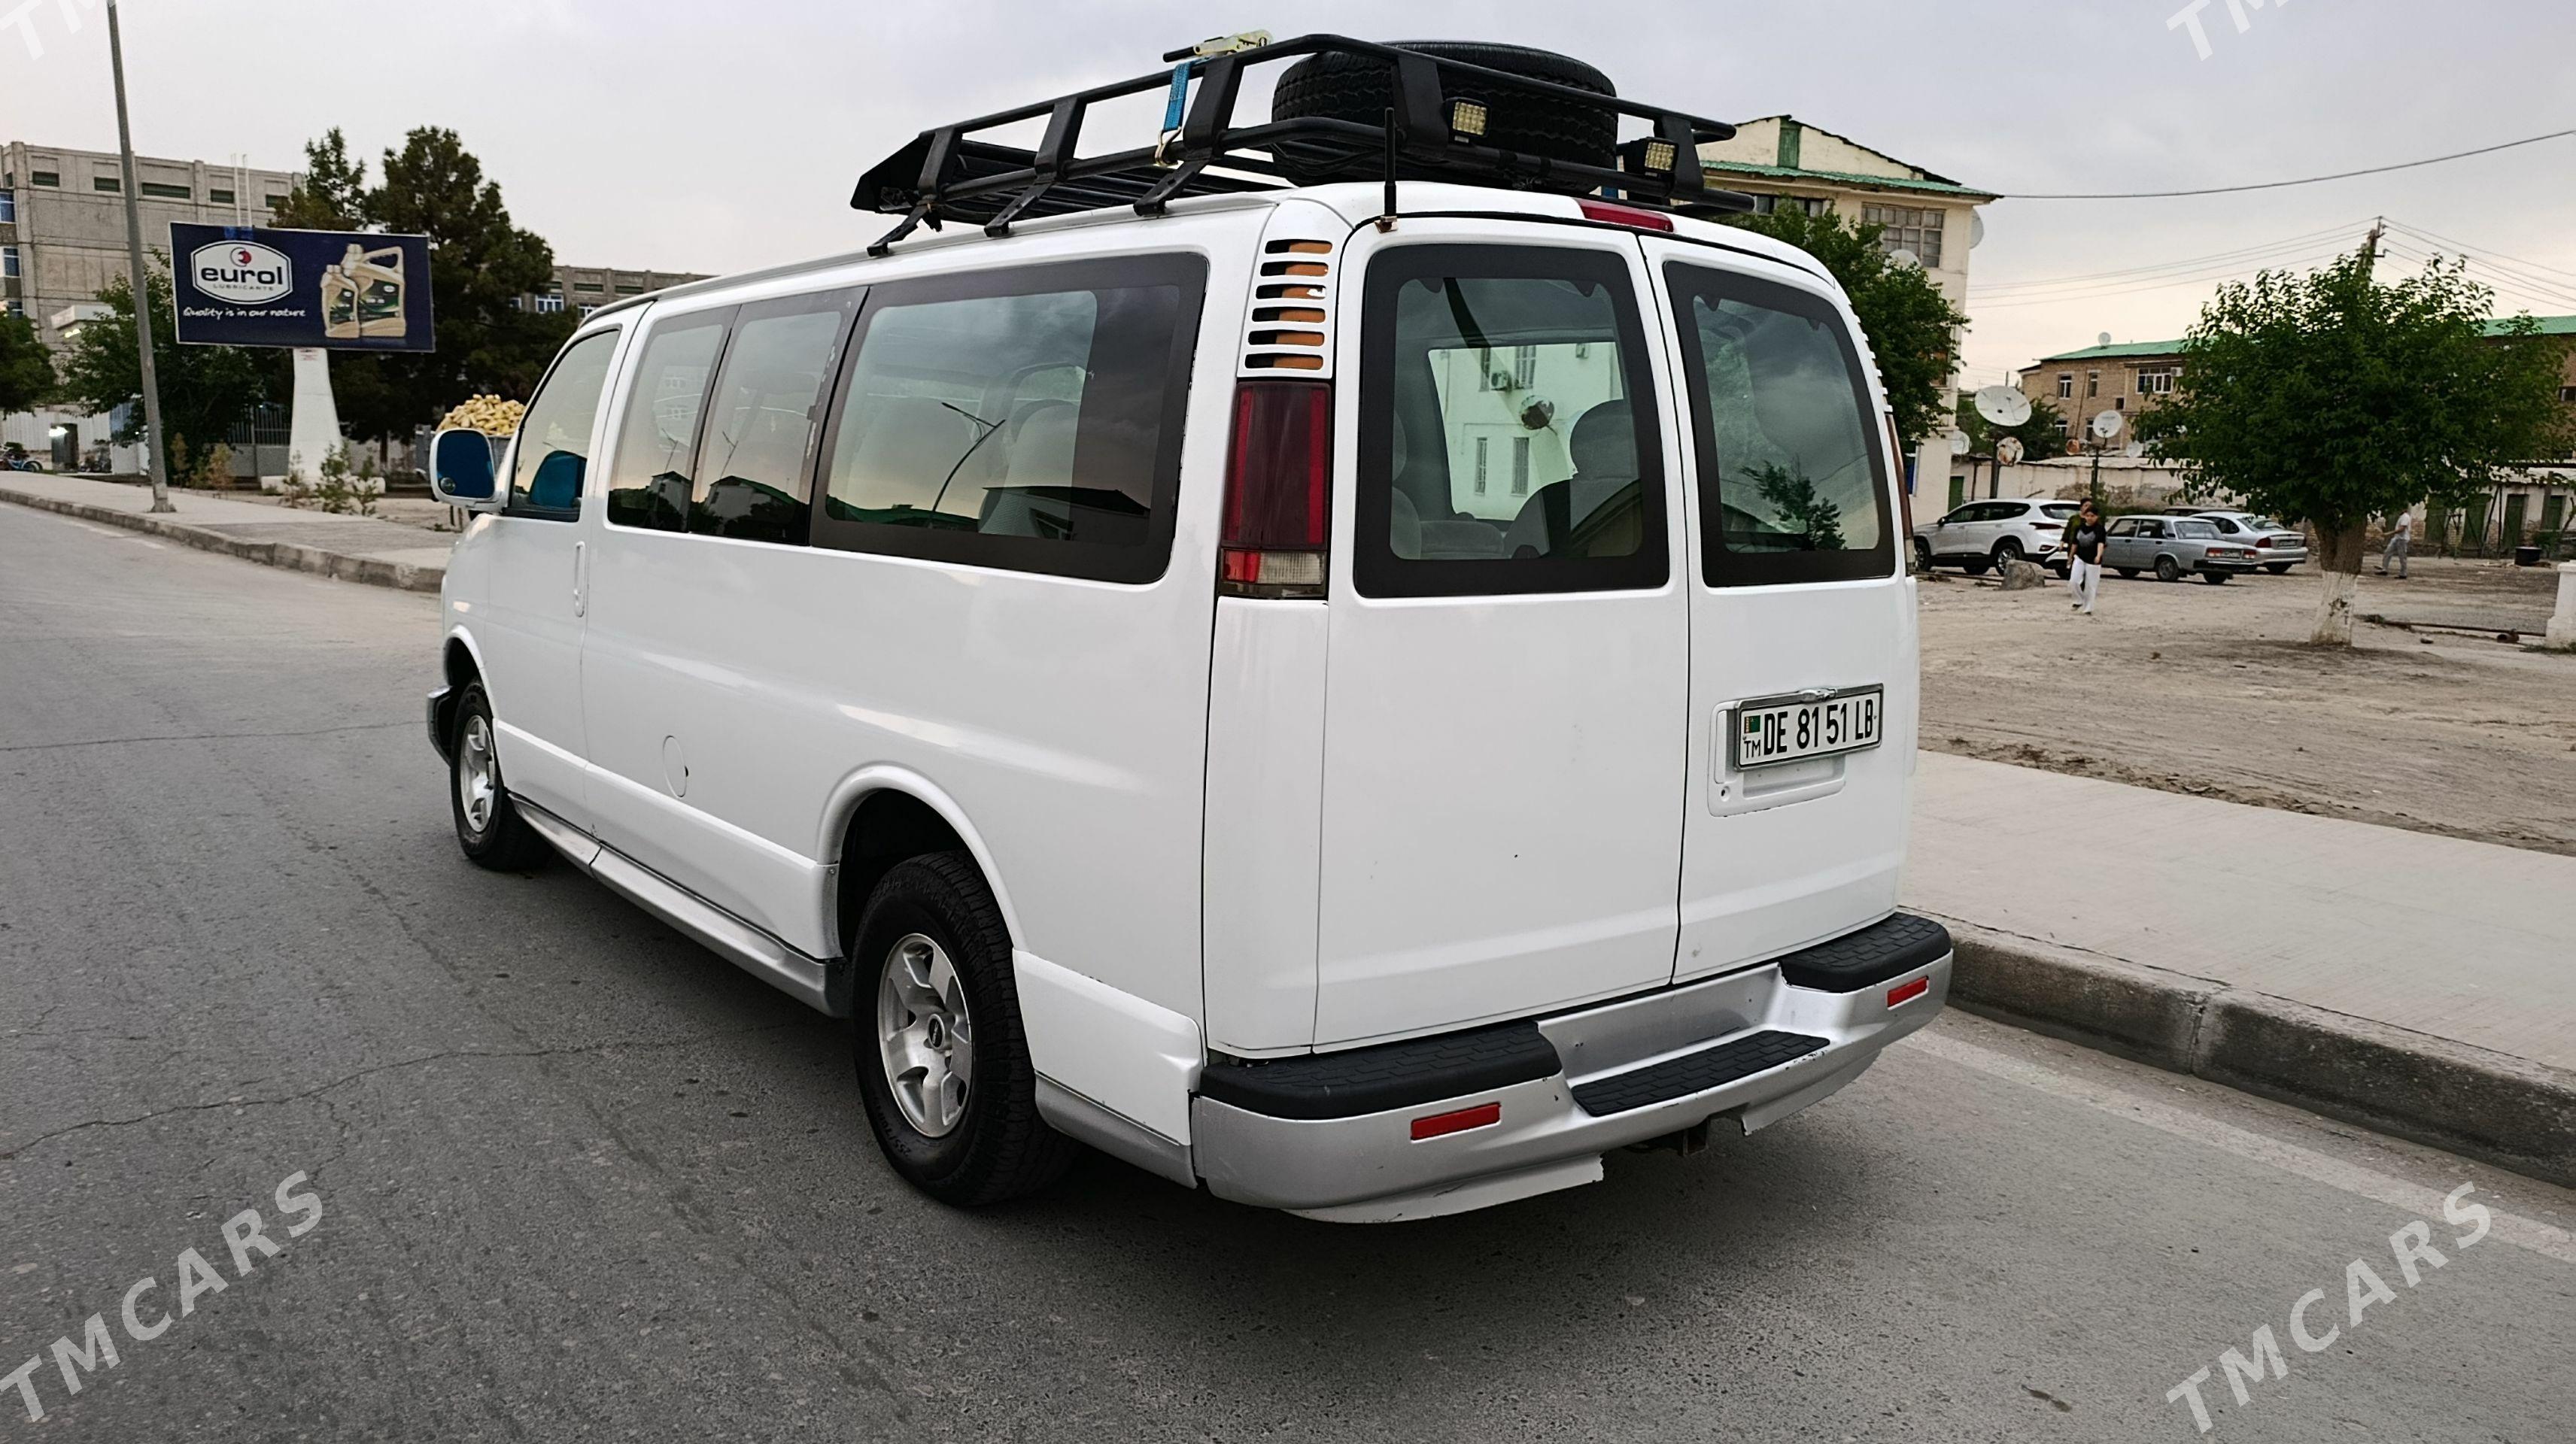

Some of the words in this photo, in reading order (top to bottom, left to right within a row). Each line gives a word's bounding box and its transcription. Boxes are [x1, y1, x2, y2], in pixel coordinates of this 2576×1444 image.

[201, 266, 283, 285] eurol
[183, 306, 223, 320] Quality
[226, 307, 235, 317] is
[237, 308, 247, 317] in
[270, 308, 306, 317] nature
[1764, 711, 1788, 756] DE
[1855, 699, 1873, 740] LB
[1744, 739, 1761, 758] TM
